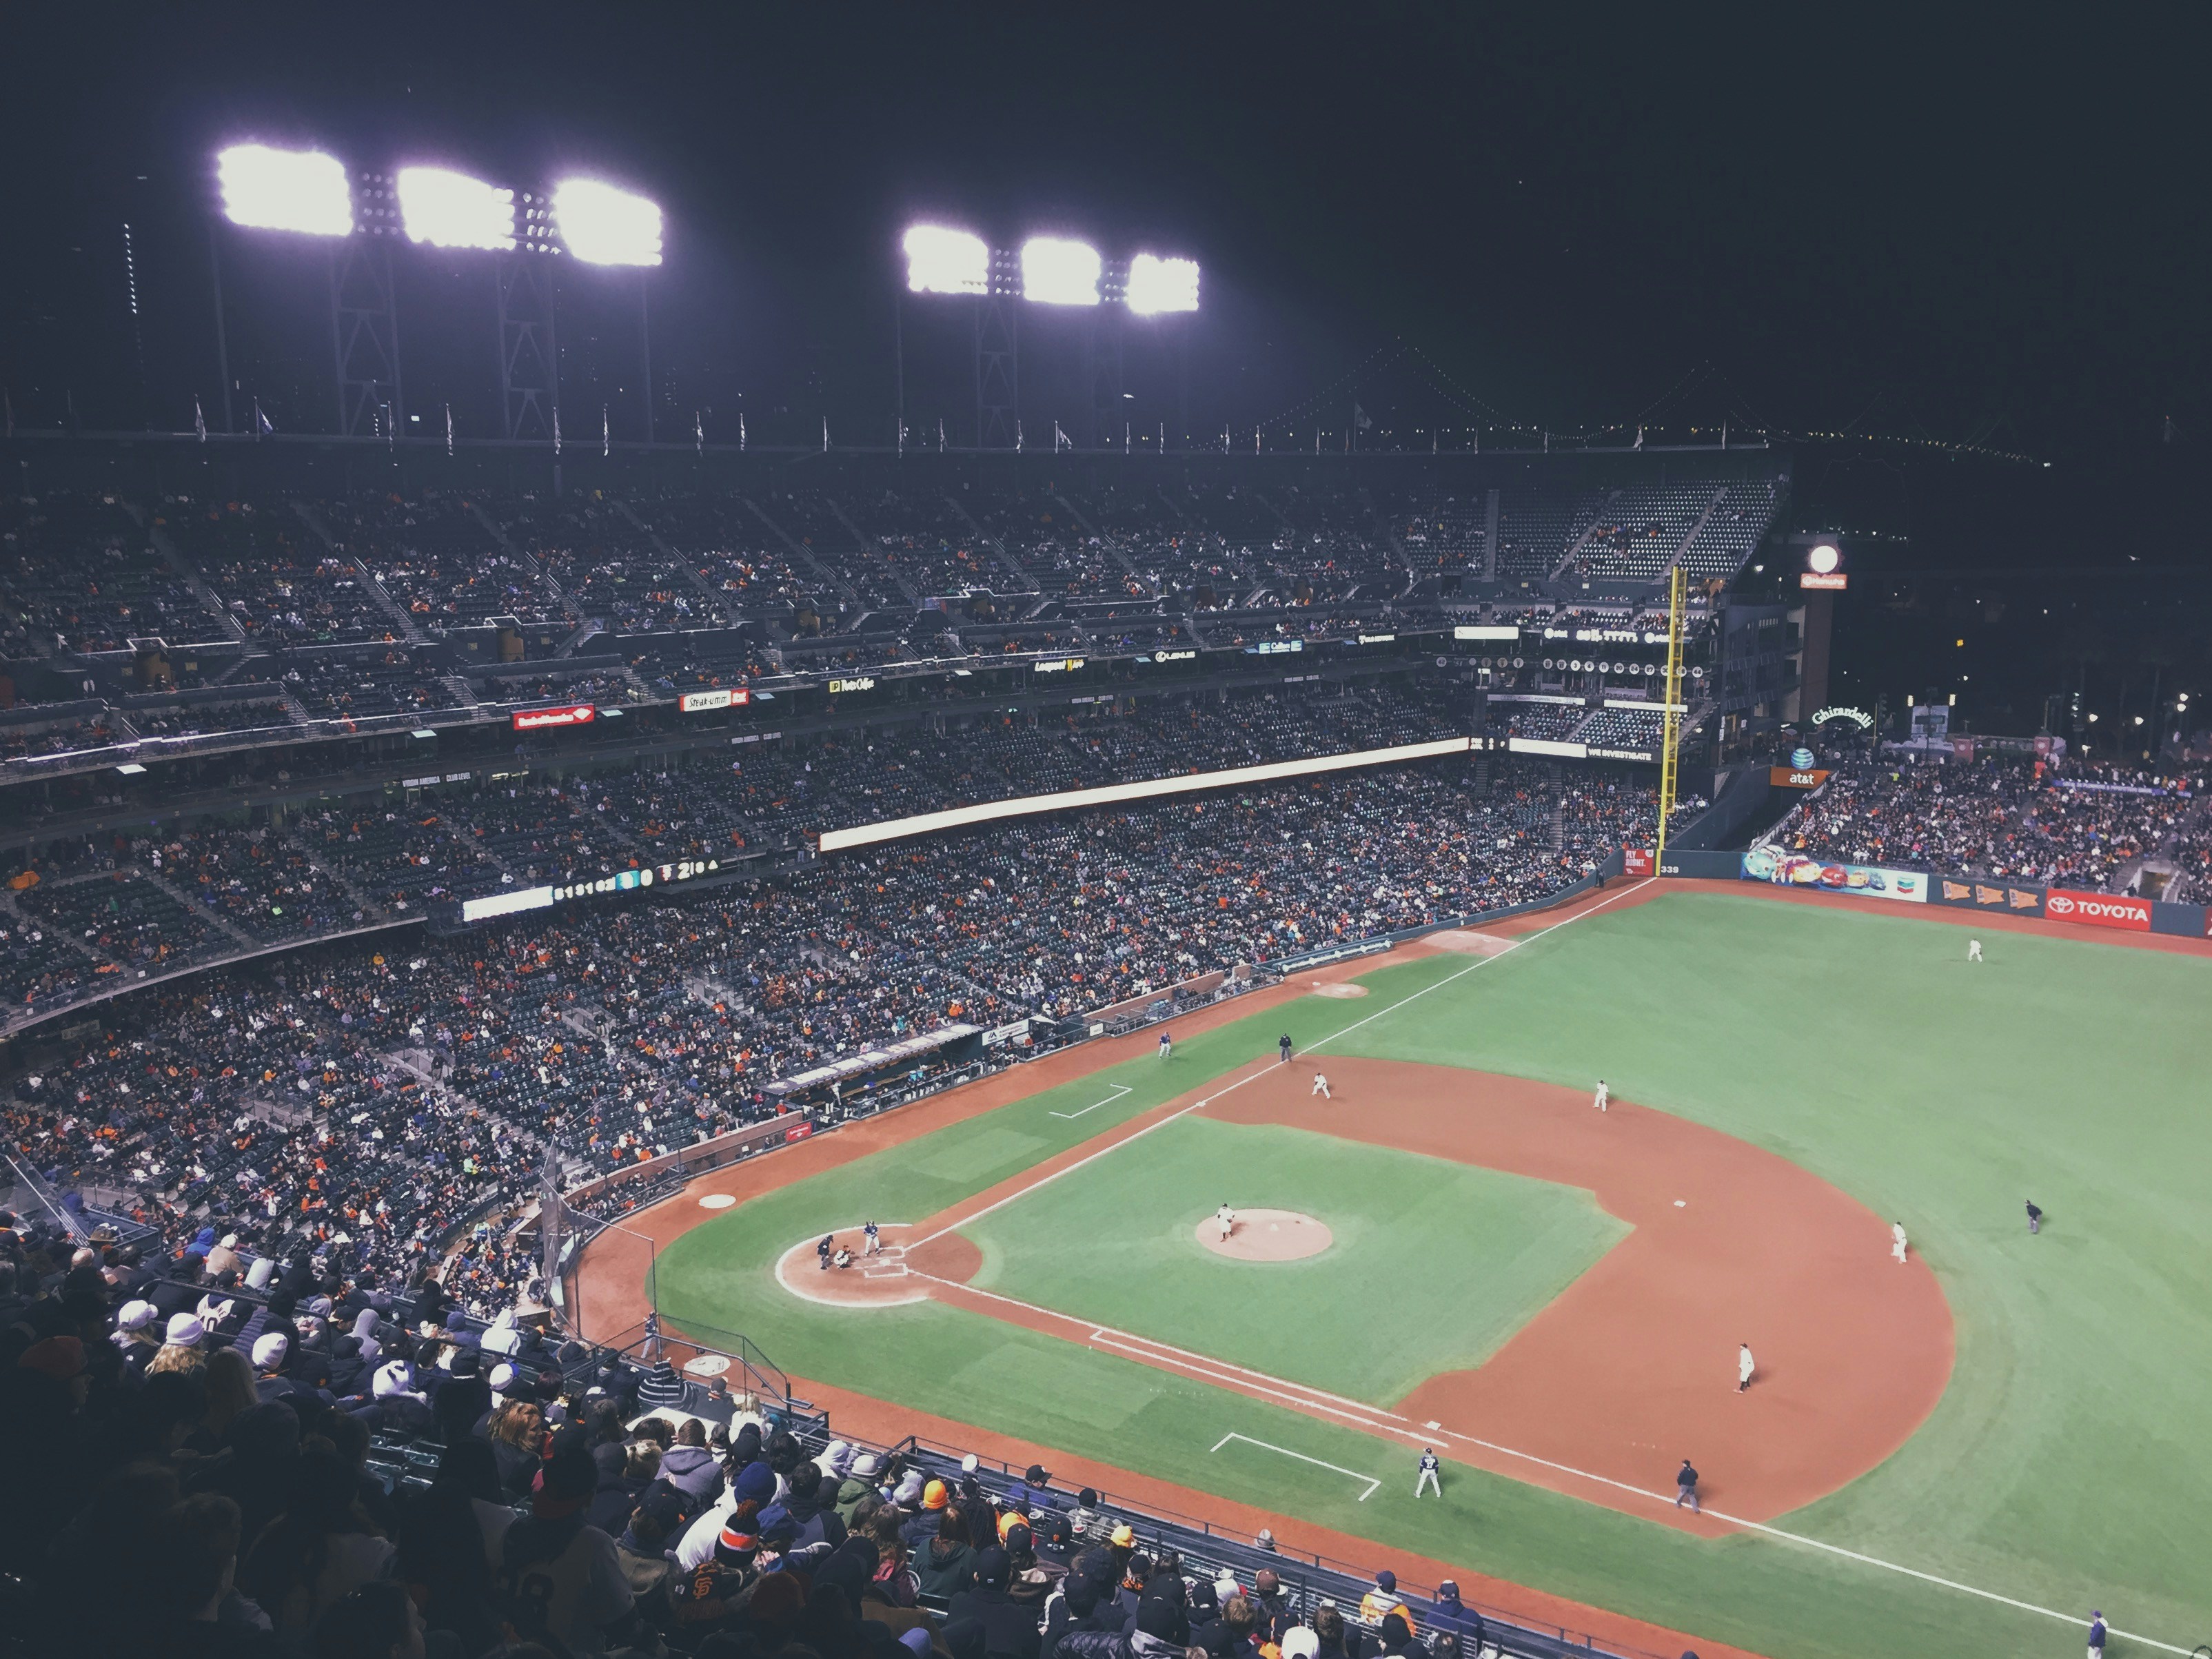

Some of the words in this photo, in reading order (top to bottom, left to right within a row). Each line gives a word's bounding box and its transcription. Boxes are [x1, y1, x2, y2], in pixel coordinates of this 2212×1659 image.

[1812, 706, 1874, 728] Ghirardelli
[1789, 773, 1814, 784] at&t
[1626, 851, 1636, 859] FLY
[2077, 901, 2149, 922] TOYOTA
